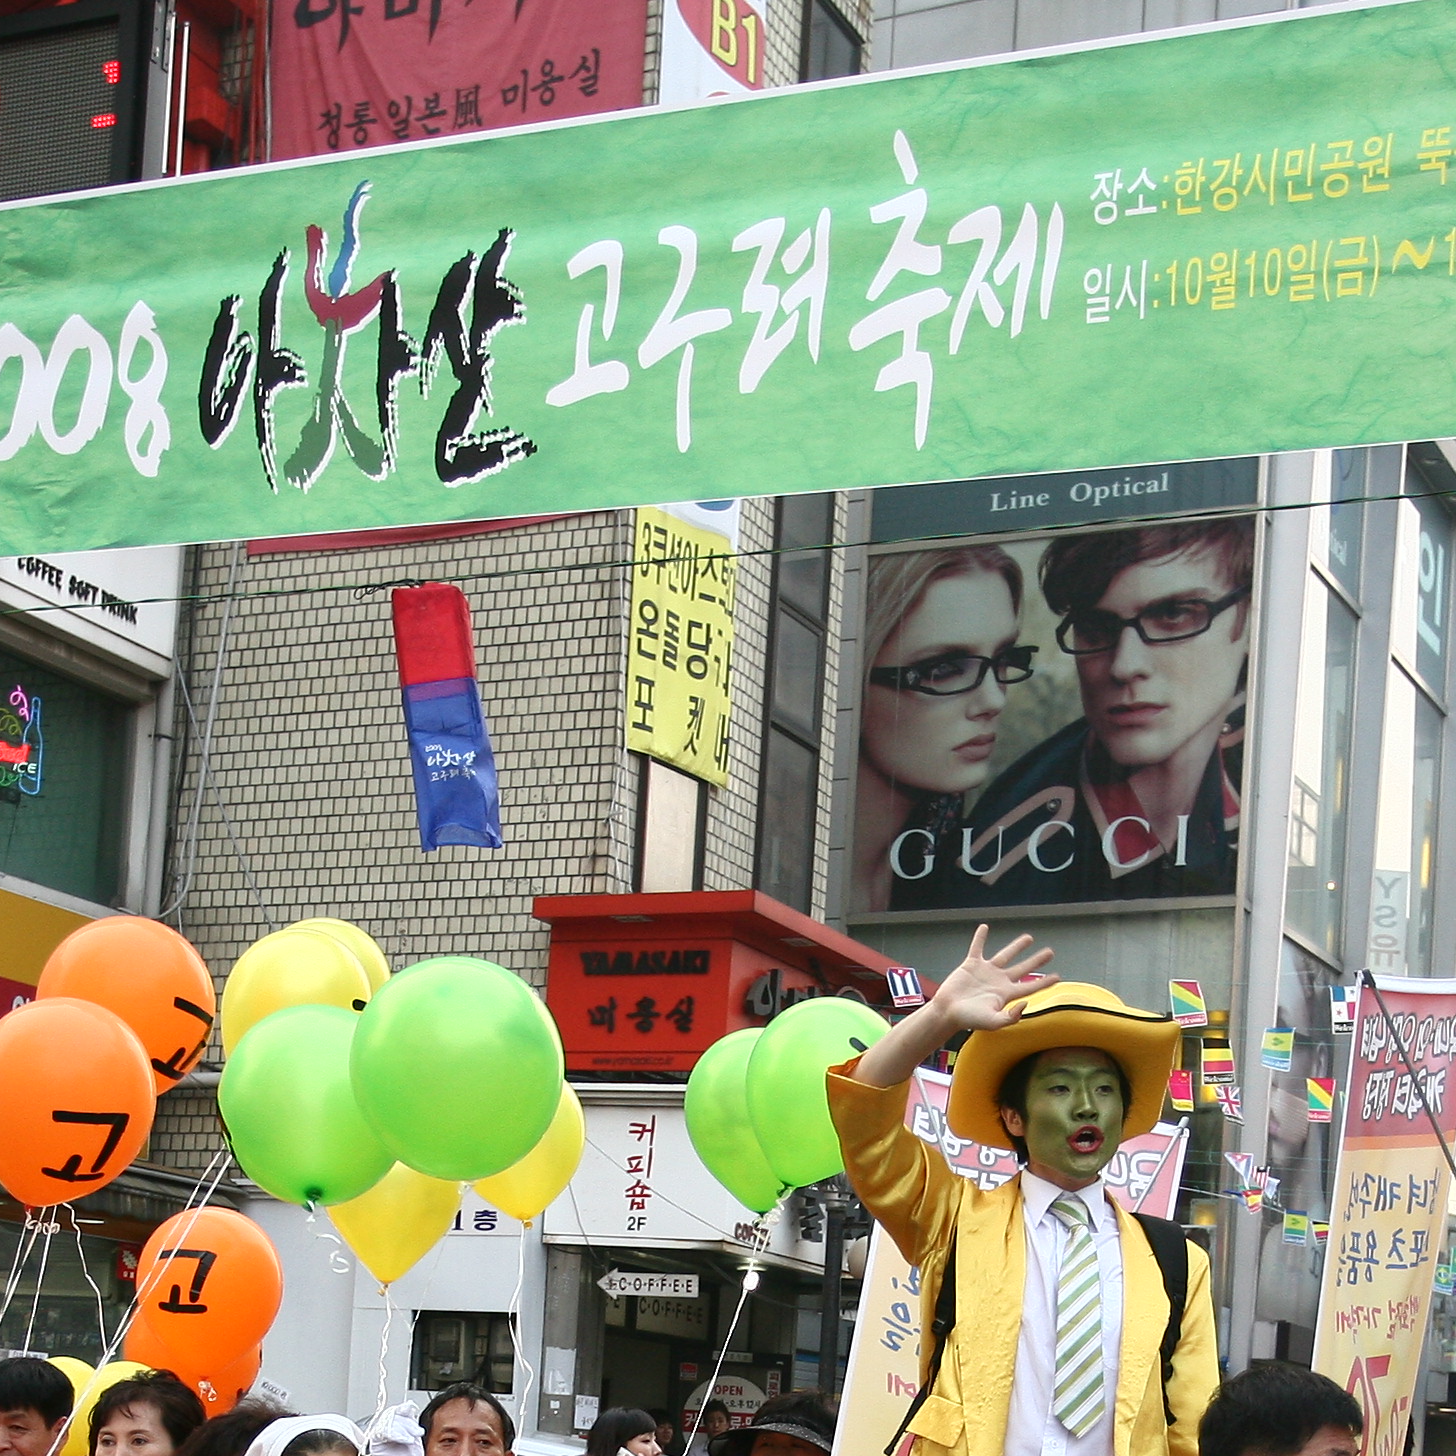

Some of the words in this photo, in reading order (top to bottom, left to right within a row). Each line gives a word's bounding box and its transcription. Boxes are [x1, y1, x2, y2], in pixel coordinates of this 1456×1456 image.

[318, 100, 382, 151] 정통
[499, 47, 603, 114] 미용실
[198, 179, 540, 494] 아차산
[545, 207, 832, 453] 고구려
[848, 128, 1065, 452] 축제
[989, 489, 1051, 514] Line
[1068, 471, 1171, 507] Optical
[12, 760, 37, 775] ICE
[889, 814, 1190, 881] GUCCI
[579, 949, 712, 977] YAMASAKI
[587, 996, 695, 1034] 미용실
[40, 1108, 132, 1182] 고
[624, 1114, 657, 1212] 커피숍
[626, 1215, 648, 1232] 2F
[157, 1248, 219, 1315] 고
[714, 1385, 744, 1396] OPEN
